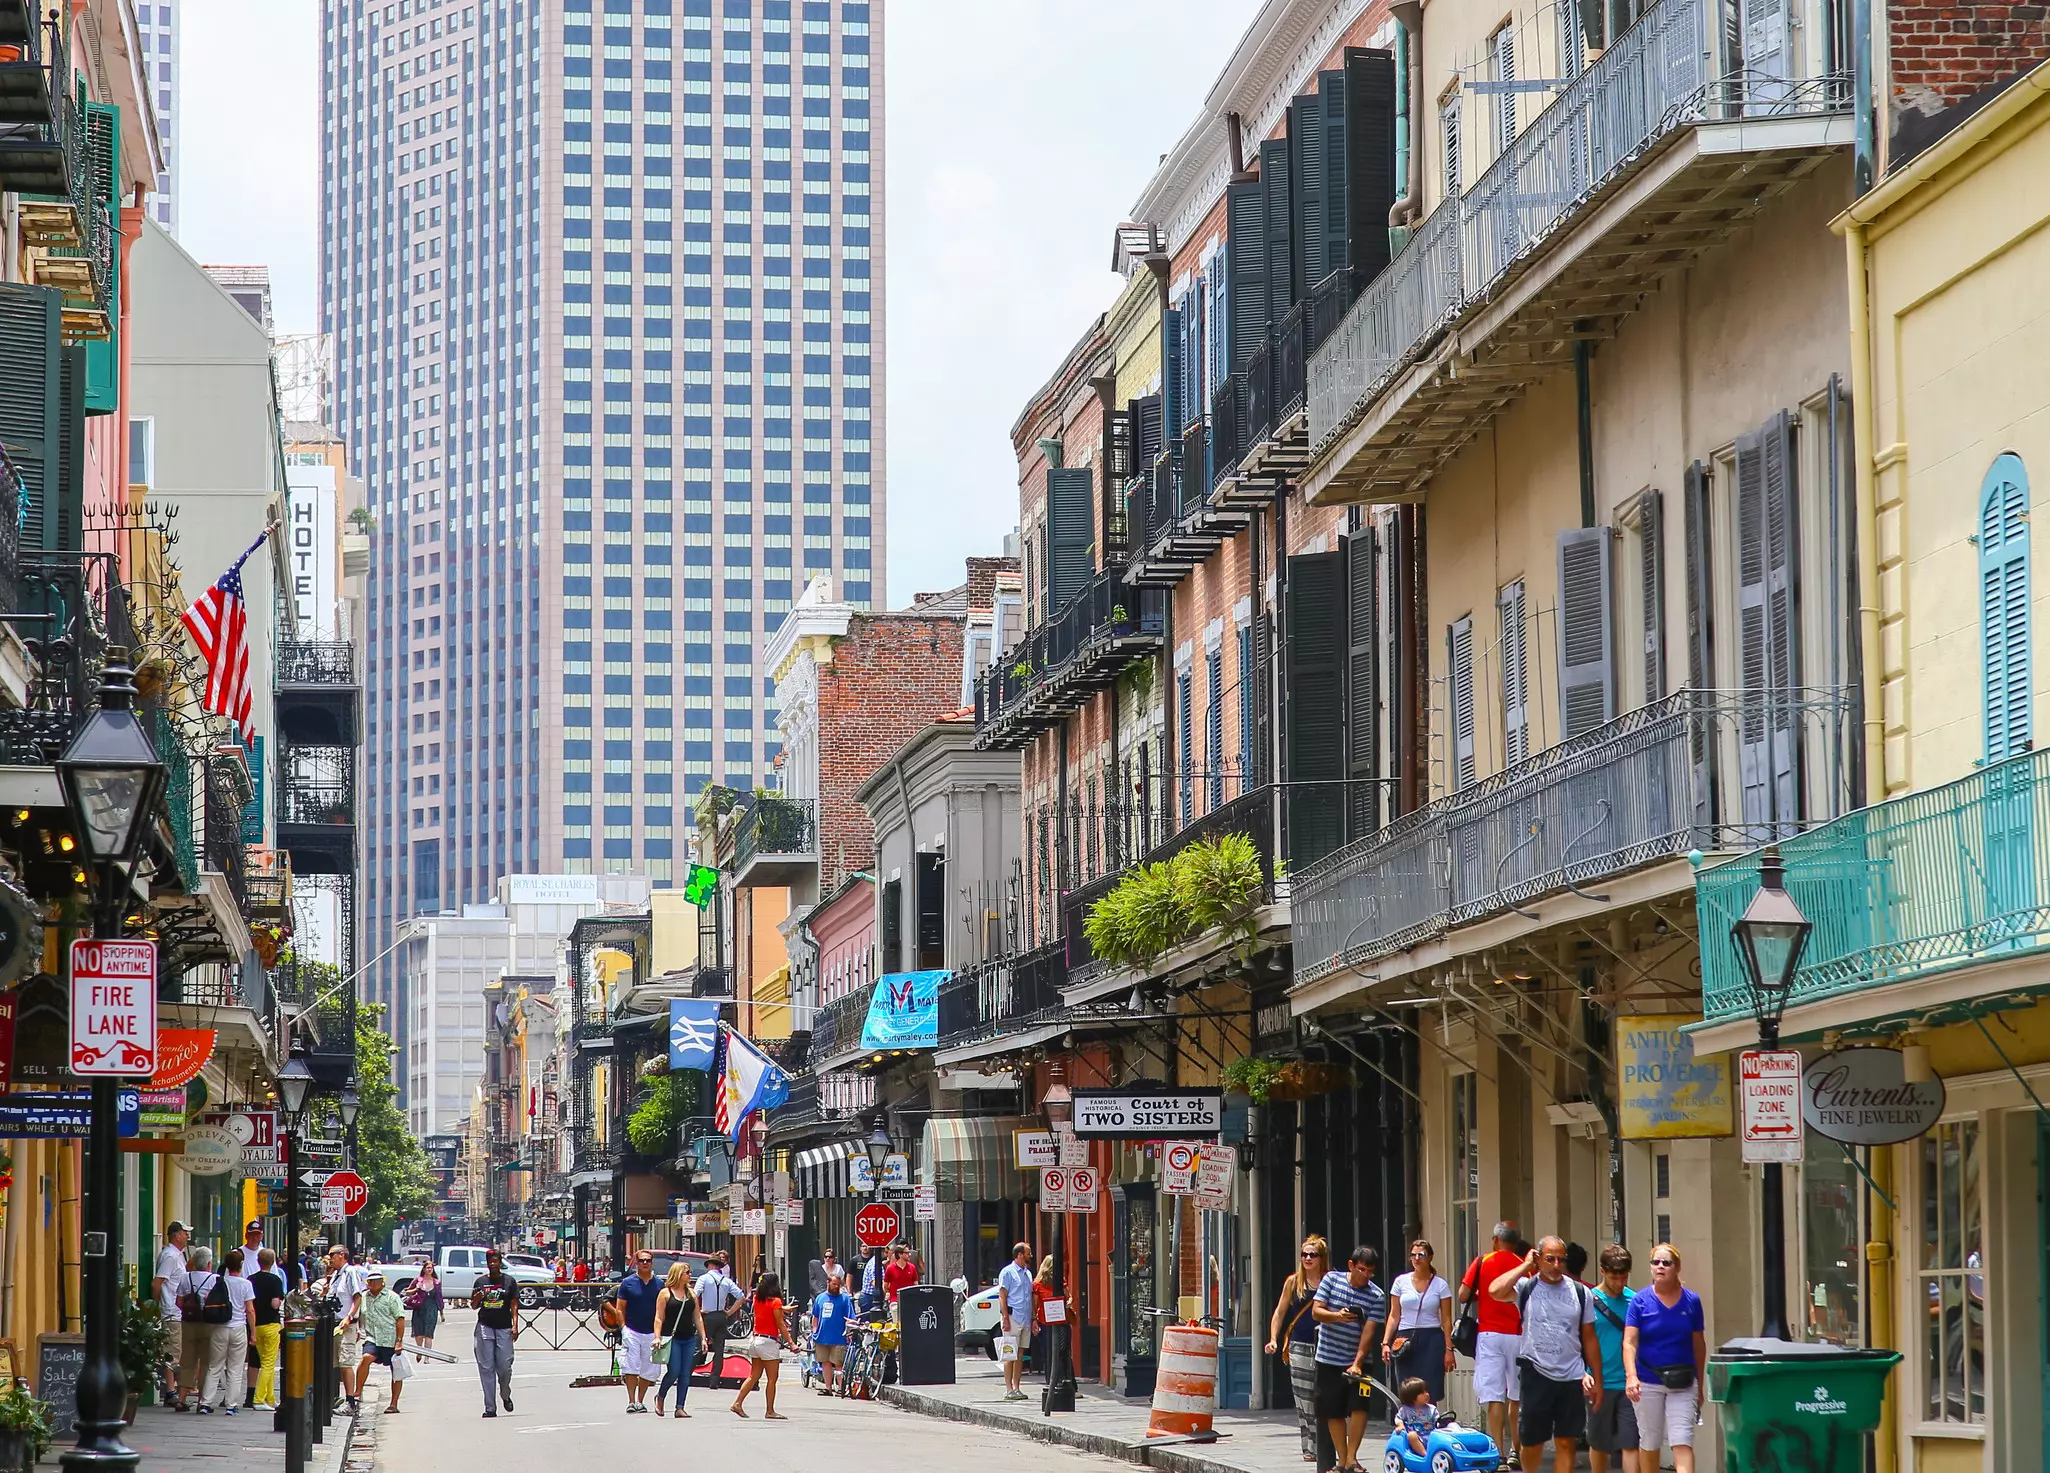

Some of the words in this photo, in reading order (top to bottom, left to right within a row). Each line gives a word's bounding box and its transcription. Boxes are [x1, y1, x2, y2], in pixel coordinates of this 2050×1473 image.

[295, 503, 312, 620] HOTEL
[513, 879, 541, 889] ROYAL
[555, 879, 595, 889] CHARLES
[103, 946, 151, 959] STOPPING
[74, 947, 101, 972] NO
[106, 961, 147, 973] ANYTIME
[92, 986, 134, 1007] FIRE
[88, 1014, 138, 1035] LANE
[1624, 1030, 1694, 1050] ANTIQU
[23, 1065, 48, 1075] SELL
[57, 1065, 71, 1075] TR
[1743, 1057, 1760, 1075] NO
[1760, 1060, 1796, 1071] PARKING
[152, 1060, 199, 1086] nchantments
[1624, 1063, 1724, 1084] PROVENCE
[1750, 1084, 1794, 1097] LOADING
[152, 1095, 180, 1104] Artists
[1130, 1098, 1180, 1110] Court
[1187, 1098, 1204, 1112] of
[1758, 1101, 1786, 1113] ZONE
[139, 1114, 161, 1123] Fairy
[162, 1114, 184, 1122] Store
[1081, 1112, 1125, 1126] TWO
[1132, 1111, 1214, 1126] SISTERS
[1819, 1110, 1855, 1125] FINE
[1857, 1109, 1923, 1127] JEWELRY
[26, 1124, 55, 1134] WHILE
[61, 1124, 69, 1134] U
[73, 1125, 91, 1135] WAI
[187, 1130, 232, 1148] OREVER
[304, 1143, 341, 1153] Toulouse
[1028, 1146, 1055, 1155] PRALIN
[1201, 1146, 1211, 1159] NO
[1211, 1149, 1231, 1160] PARKING
[198, 1156, 231, 1164] ORLEANS
[240, 1149, 274, 1161] OYALE
[1202, 1163, 1228, 1173] LOADING
[882, 1174, 903, 1183] oyale
[321, 1189, 330, 1197] NO
[345, 1185, 364, 1202] OP
[883, 1189, 914, 1198] Toulou
[858, 1217, 896, 1234] STOP
[1795, 1399, 1847, 1413] Progressive
